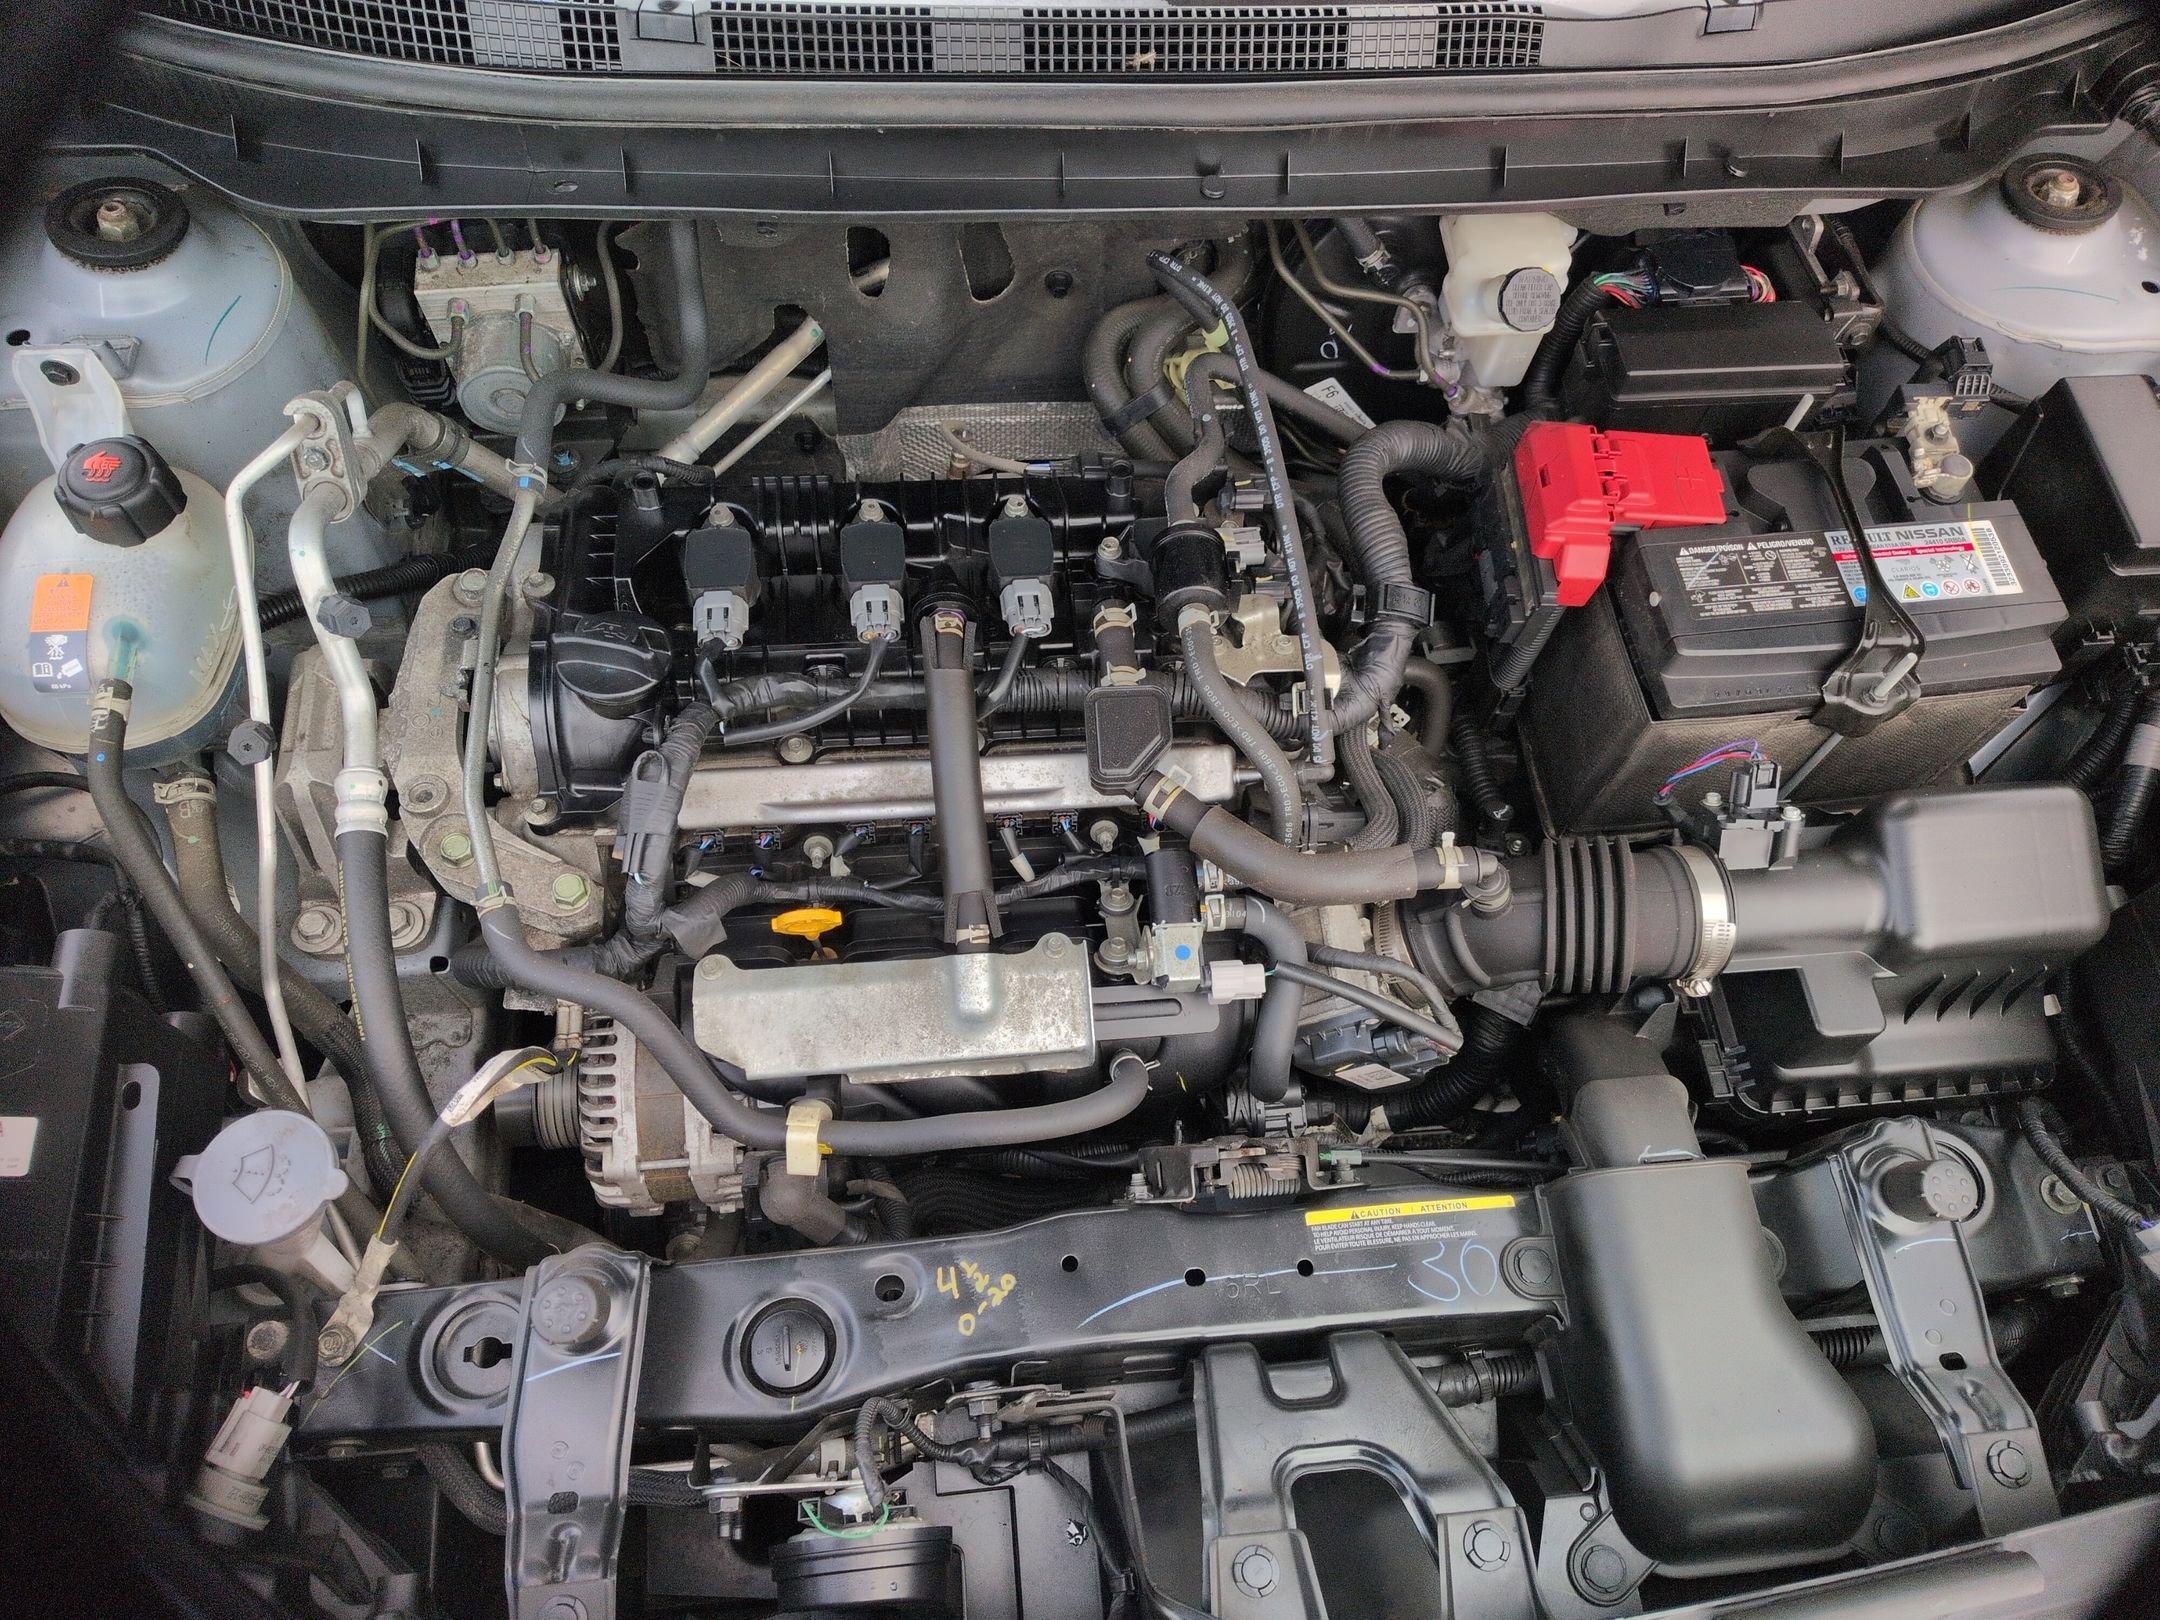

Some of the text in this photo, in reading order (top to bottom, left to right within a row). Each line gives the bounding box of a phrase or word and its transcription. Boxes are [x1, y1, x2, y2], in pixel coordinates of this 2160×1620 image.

[1248, 390, 1260, 408] KINK
[1254, 410, 1264, 423] NOT
[1282, 533, 1294, 554] KINK
[1831, 526, 1966, 546] REULT NISSAN
[1287, 558, 1296, 572] NOT
[1360, 1202, 1468, 1218] CAUTION ATTENTION
[1320, 1234, 1355, 1244] VENTILATEUR
[1349, 1227, 1373, 1235] PERSONAL
[936, 1266, 960, 1300] 4
